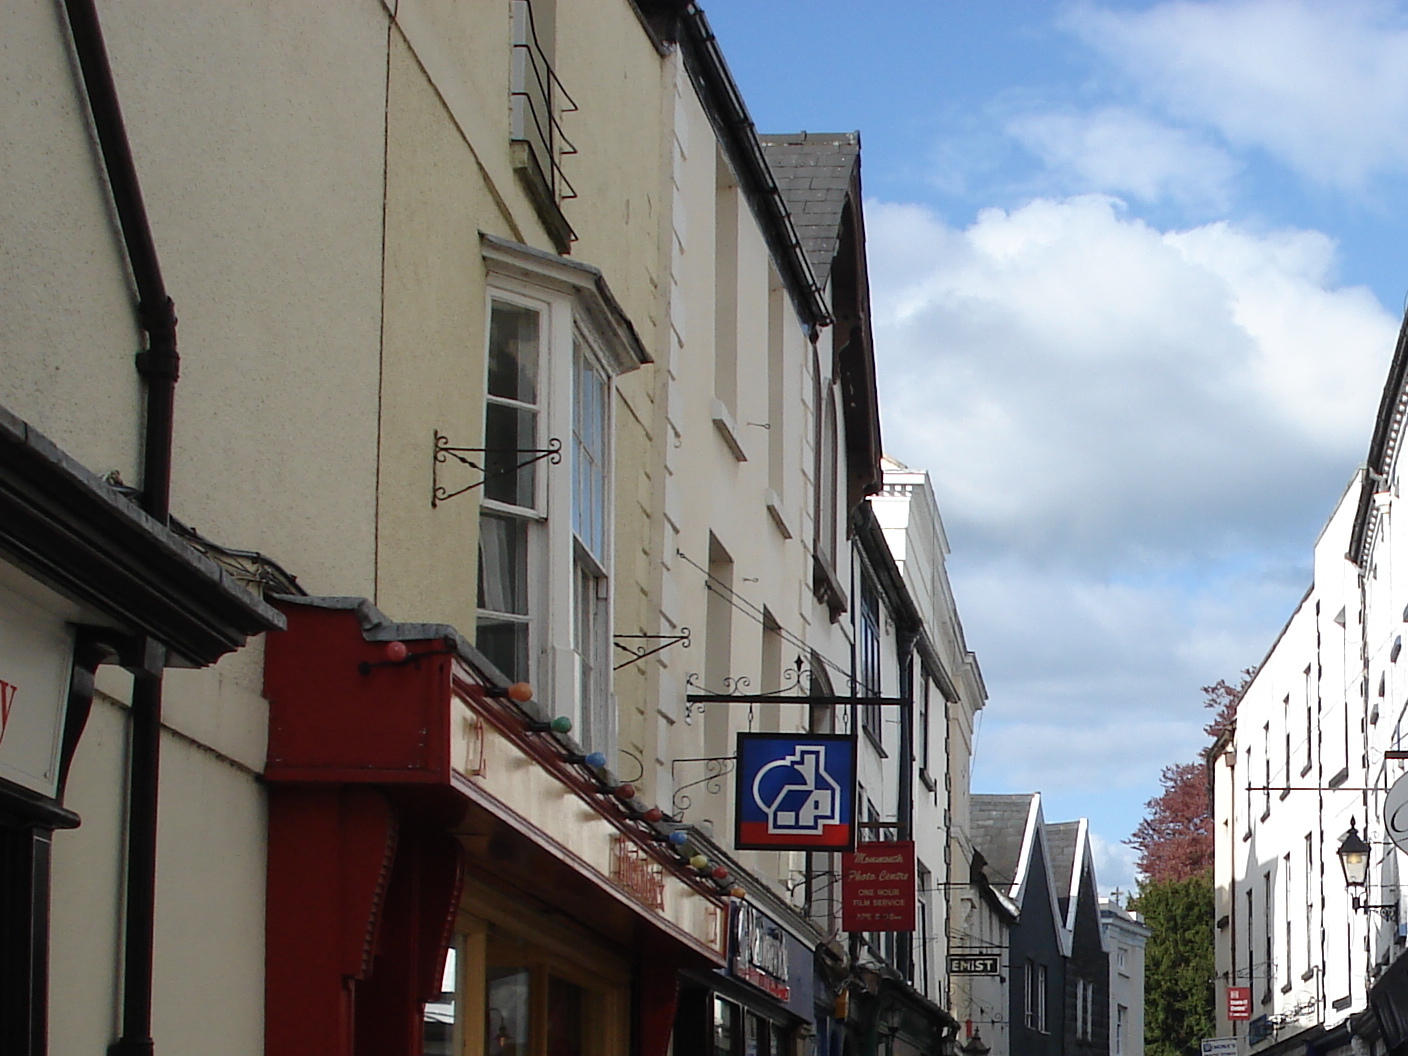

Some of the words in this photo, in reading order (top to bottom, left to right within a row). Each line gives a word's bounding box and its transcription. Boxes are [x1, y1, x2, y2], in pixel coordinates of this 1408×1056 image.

[848, 870, 876, 882] Photo
[878, 870, 910, 881] Centre
[853, 899, 871, 907] FILM
[873, 899, 905, 907] SERVICE
[951, 960, 994, 971] EMIST
